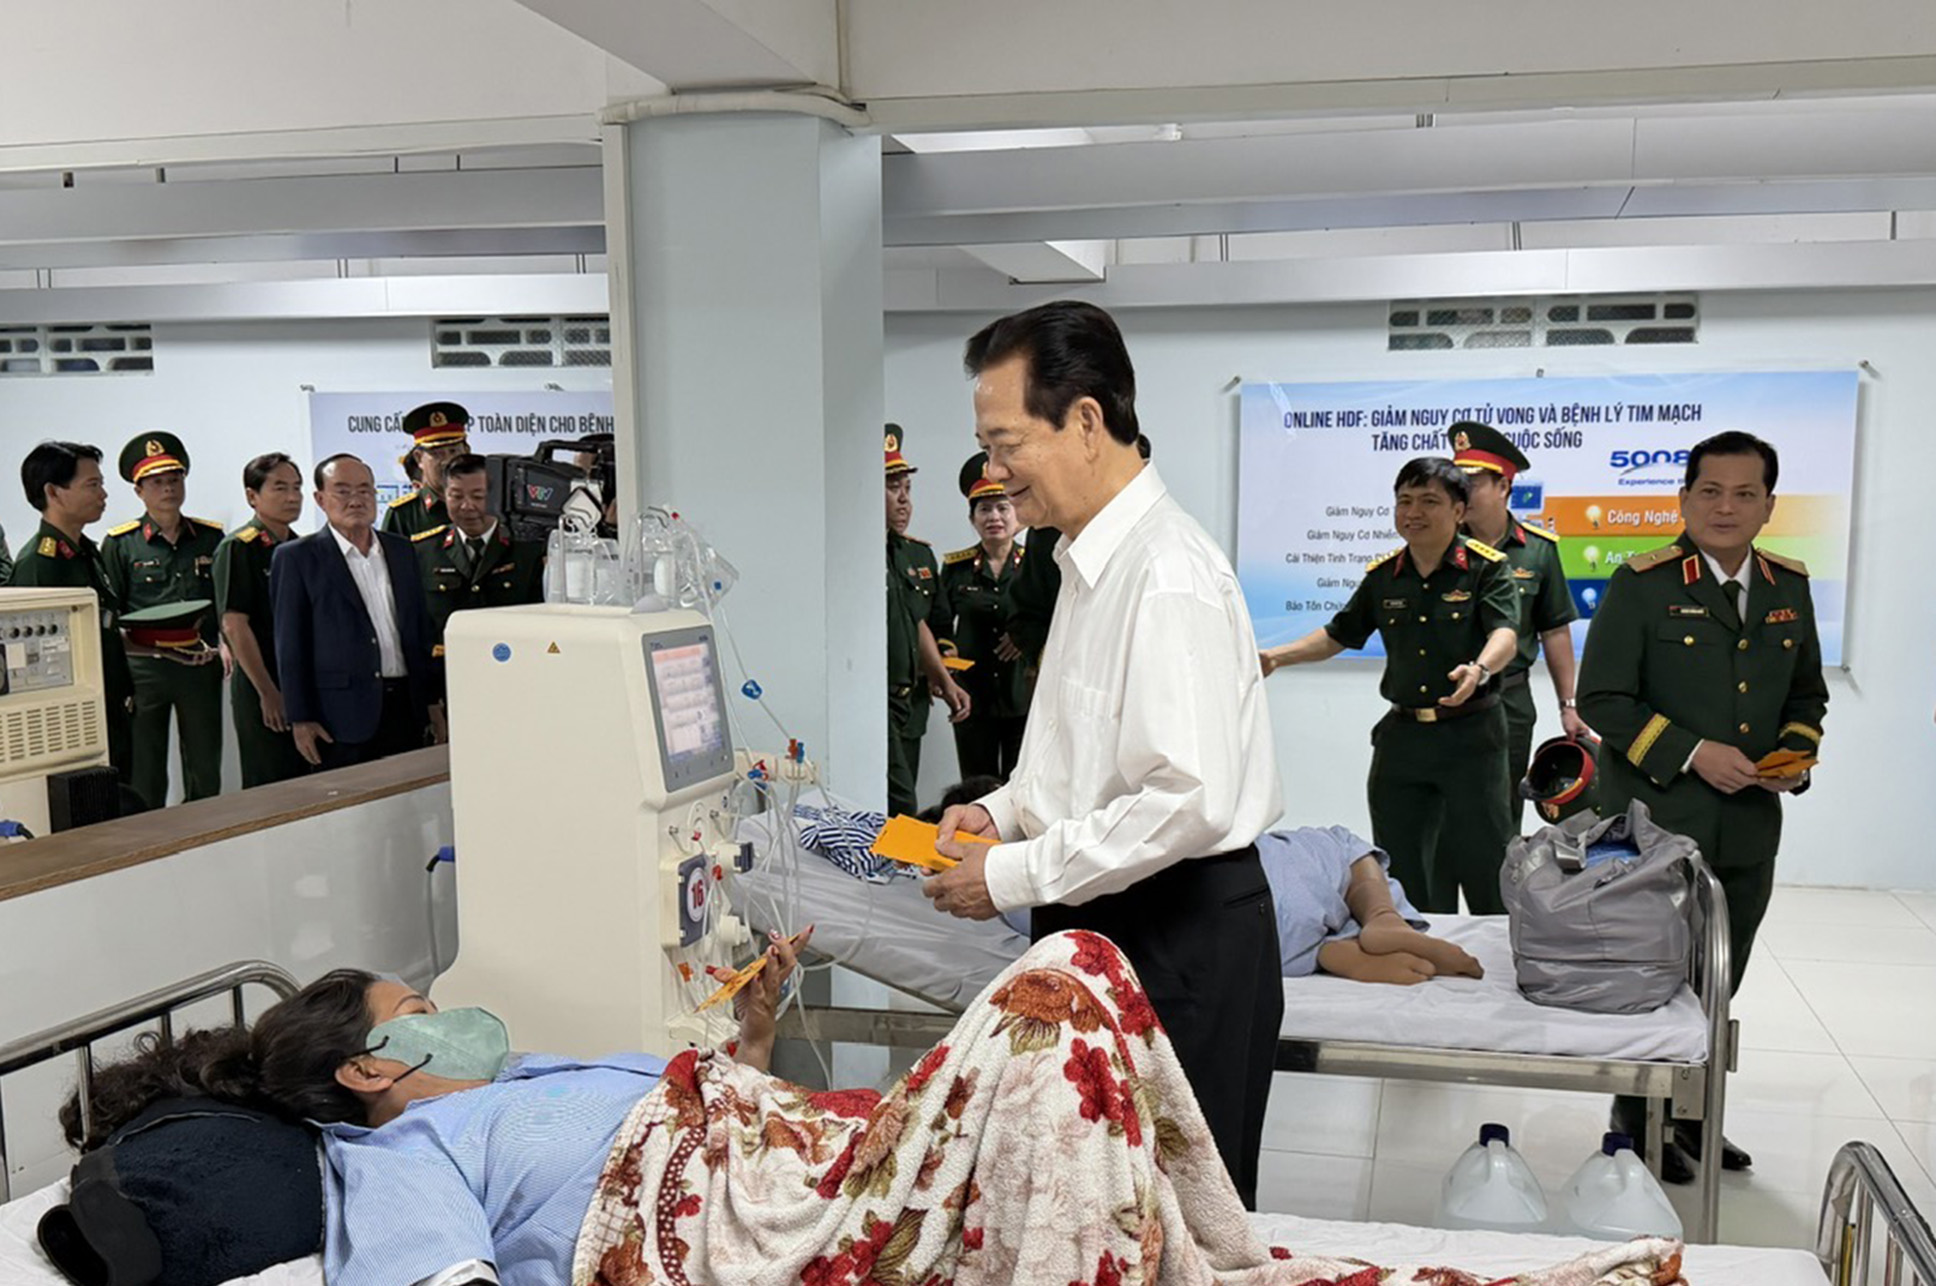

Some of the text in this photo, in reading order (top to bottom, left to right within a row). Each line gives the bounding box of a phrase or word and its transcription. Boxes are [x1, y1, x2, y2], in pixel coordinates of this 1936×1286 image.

[347, 411, 405, 433] CUNG CẤ
[478, 412, 512, 433] TOÀN
[516, 412, 546, 436] DIỆN
[550, 415, 576, 433] CHO
[1283, 411, 1333, 429] ONLINE
[1336, 411, 1368, 428] HDF:
[1371, 405, 1406, 428] GIẢM
[1410, 409, 1449, 427] NGUY
[1475, 403, 1493, 424] TỬ
[1497, 407, 1534, 425] VONG
[1536, 405, 1557, 424] VÀ
[1562, 403, 1600, 426] BỆNH
[1604, 402, 1623, 422] LÝ
[1624, 404, 1654, 422] TIM
[1657, 403, 1702, 425] MẠCH
[1372, 431, 1409, 451] TĂNG
[1412, 428, 1449, 450] CHẤT
[1543, 426, 1583, 449] SỐNG
[1617, 477, 1675, 487] Experience
[1325, 505, 1349, 517] Giảm
[1351, 506, 1374, 518] Nguy
[1607, 508, 1641, 526] Công
[1306, 529, 1331, 540] Giảm
[1332, 529, 1355, 541] Nguy
[1317, 577, 1340, 588] Giảm
[691, 879, 705, 910] 16
